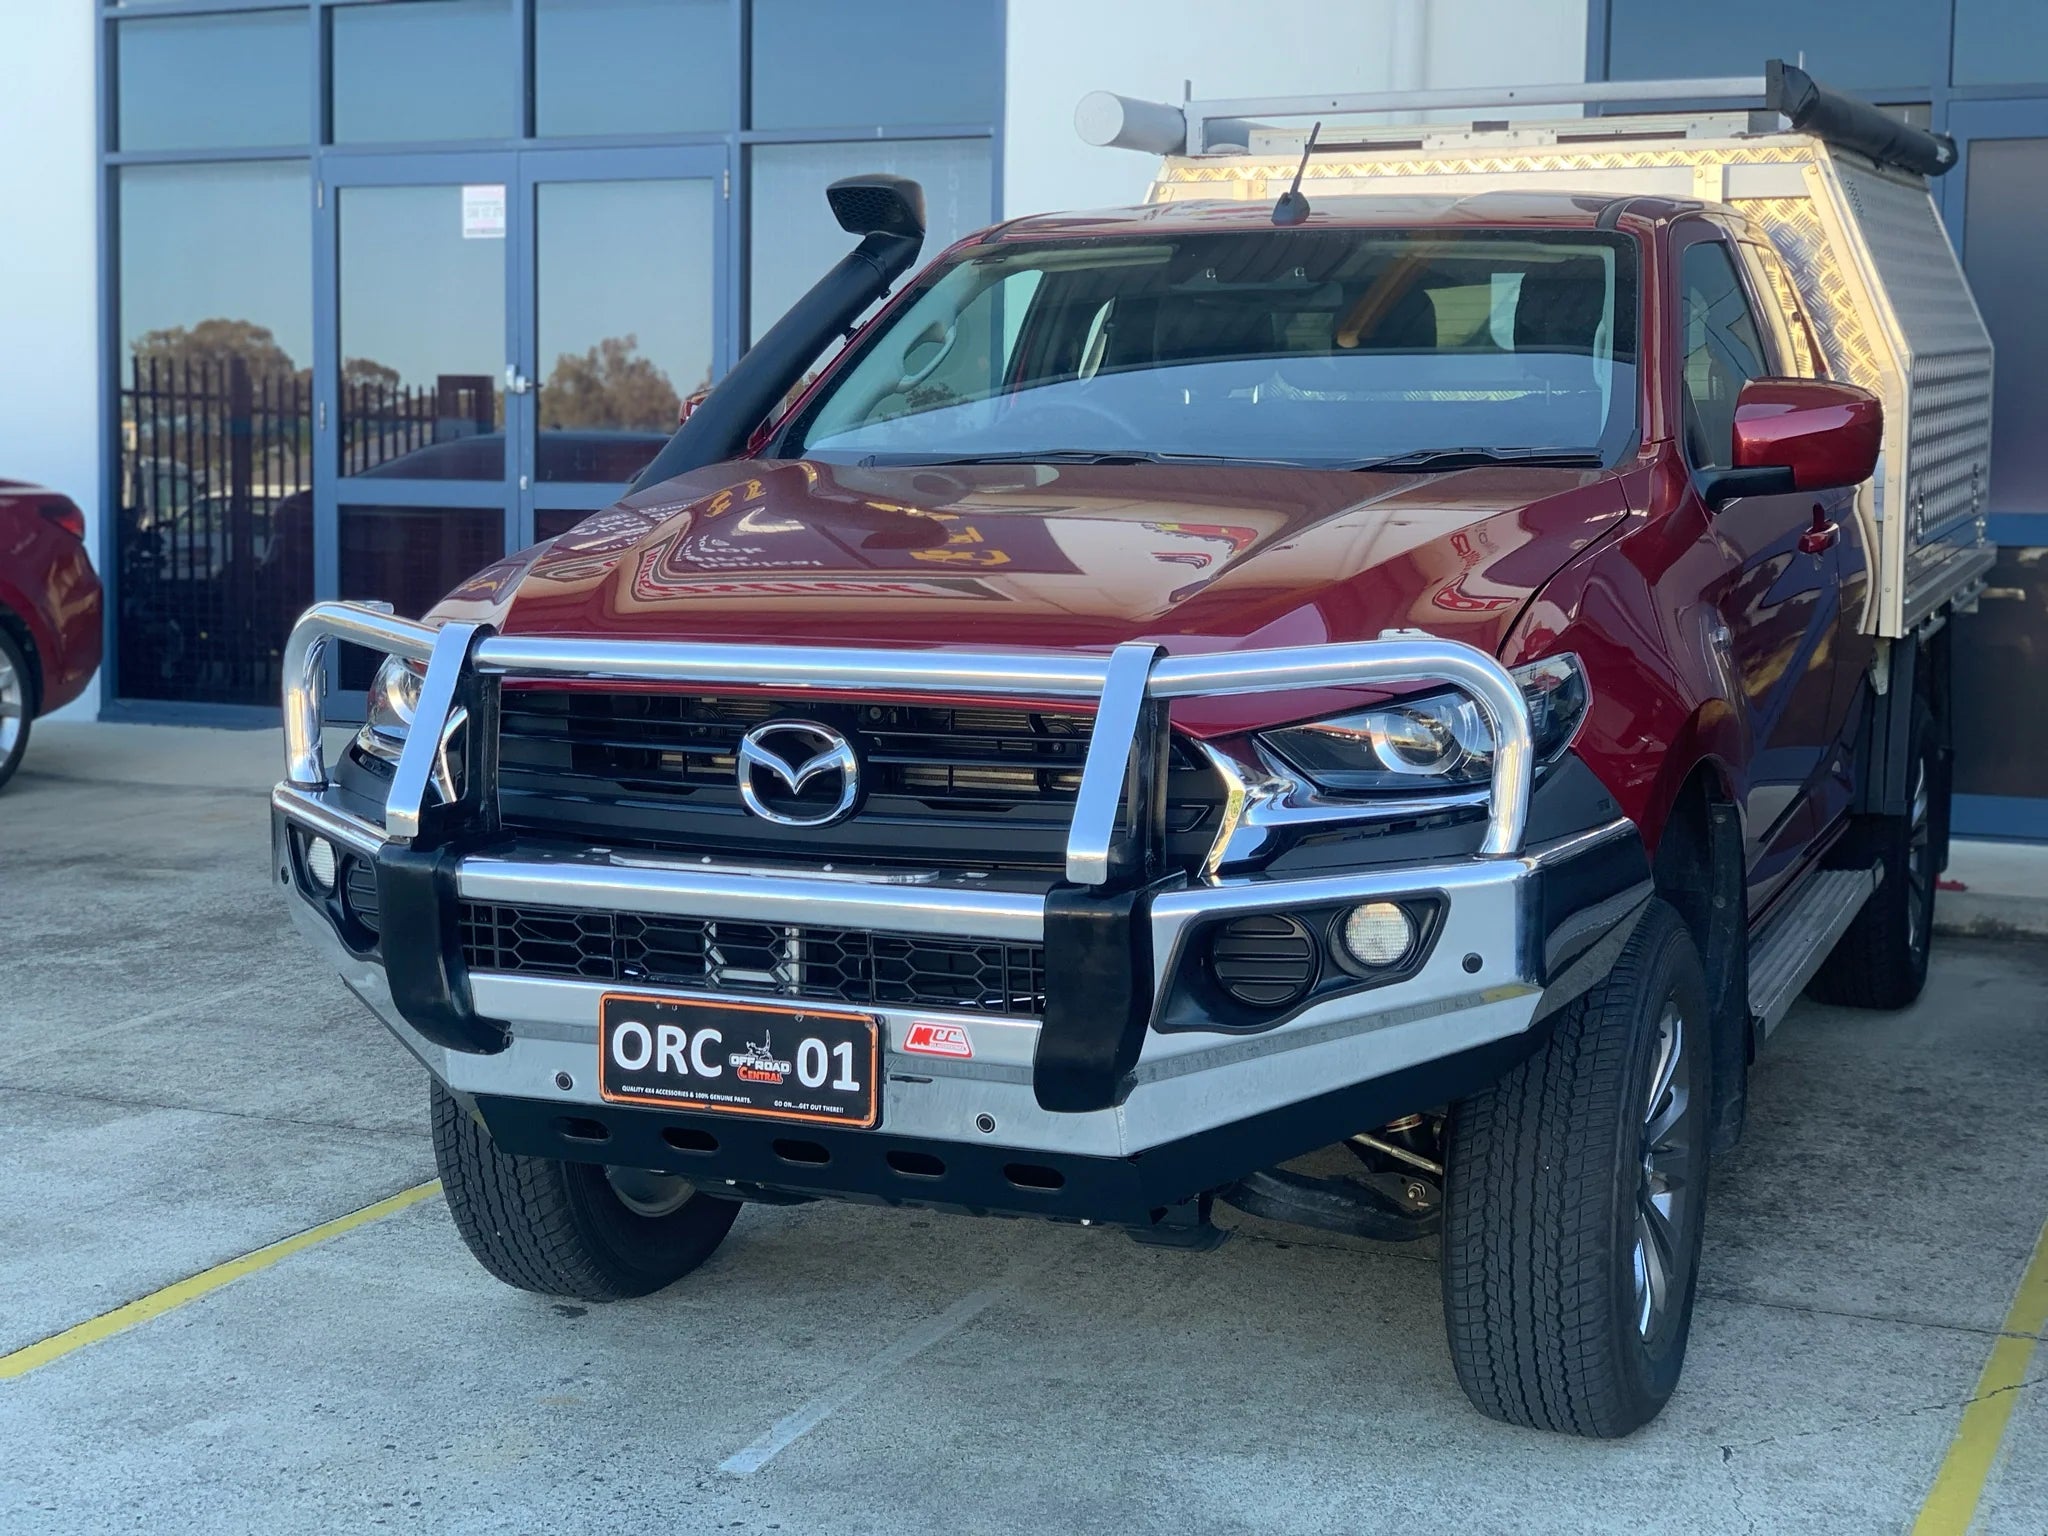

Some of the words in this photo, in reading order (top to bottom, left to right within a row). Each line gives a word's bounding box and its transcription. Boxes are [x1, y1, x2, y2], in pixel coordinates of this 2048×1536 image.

[612, 1021, 723, 1078] ORC
[797, 1038, 860, 1092] 01
[622, 1085, 645, 1094] QUALITY
[645, 1086, 655, 1095] 4X4
[655, 1088, 689, 1098] ACCESSORIES
[695, 1091, 709, 1100] 100%
[710, 1094, 733, 1102] GENUINE
[734, 1096, 752, 1104] PARTS.
[810, 1103, 821, 1111] OUT
